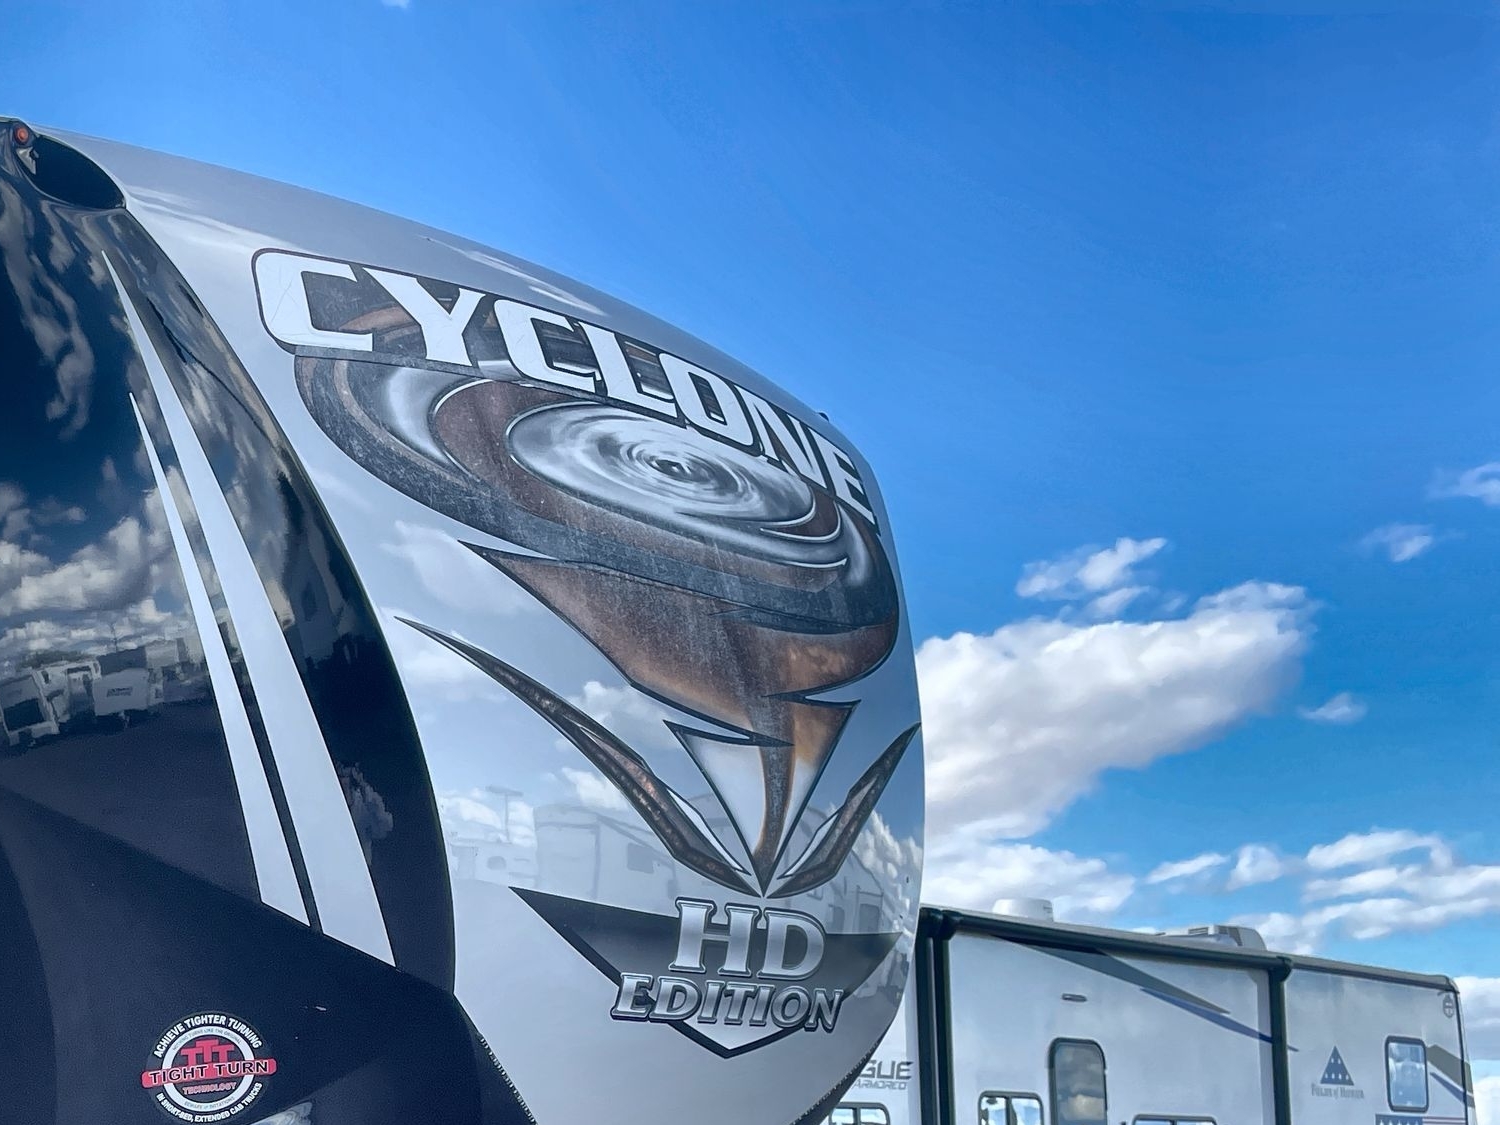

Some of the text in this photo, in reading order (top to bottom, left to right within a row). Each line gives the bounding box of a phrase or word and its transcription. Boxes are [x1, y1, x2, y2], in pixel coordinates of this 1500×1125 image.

[254, 250, 877, 527] CYCLONE
[668, 896, 826, 981] HD
[610, 972, 844, 1034] EDITION
[153, 1014, 263, 1059] ACHIEVE TIGHTER TURNING
[149, 1060, 269, 1084] TIGHT TURN
[181, 1081, 237, 1096] TECHNOLOGY
[156, 1092, 165, 1102] IN
[194, 1110, 231, 1123] EXTENDED
[230, 1103, 245, 1115] CAB
[241, 1082, 263, 1106] TRUCKS
